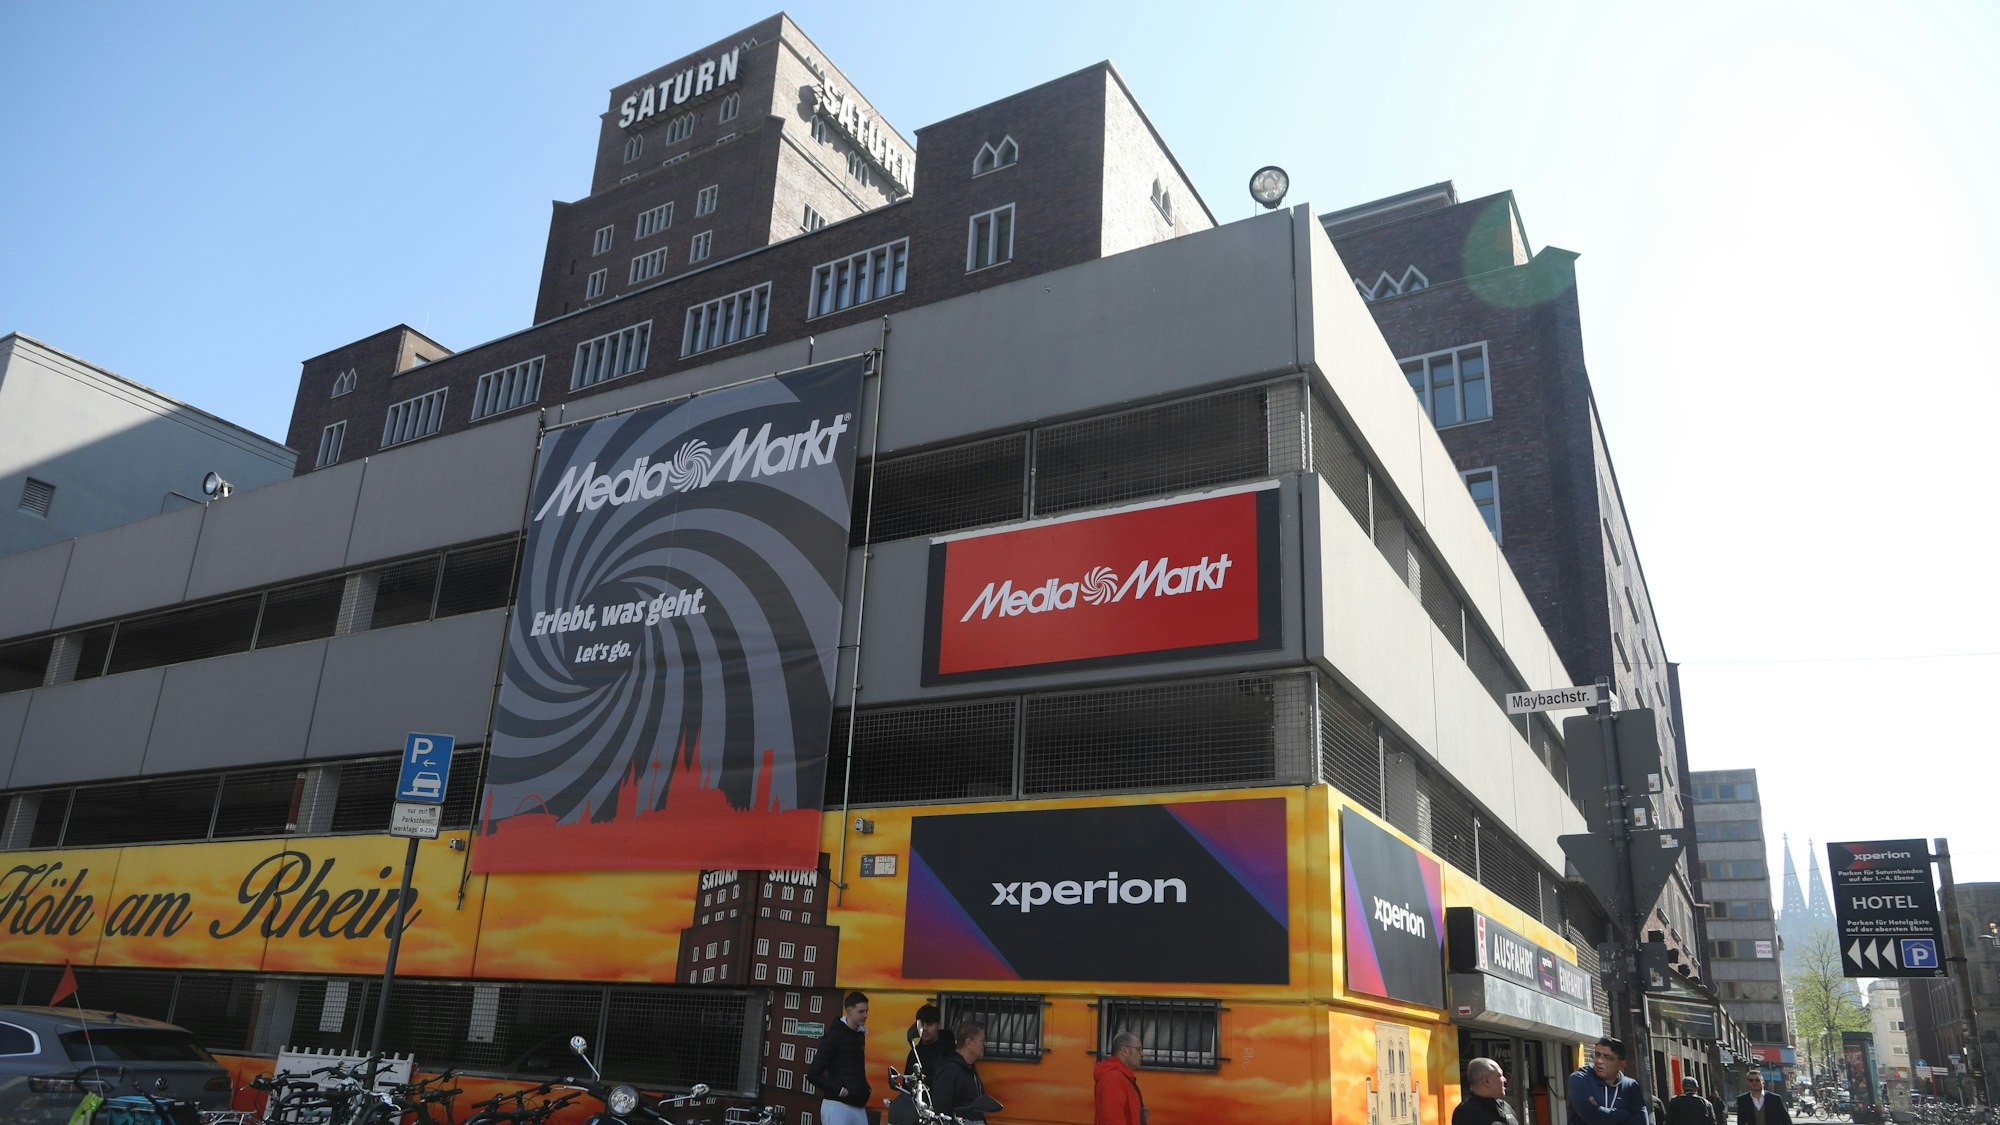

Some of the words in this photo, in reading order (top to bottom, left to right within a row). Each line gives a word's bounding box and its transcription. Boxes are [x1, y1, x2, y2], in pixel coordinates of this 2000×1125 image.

[618, 46, 740, 129] SATURN
[822, 77, 915, 192] SATURN
[530, 603, 597, 637] Erlebt,
[601, 600, 646, 627] was
[645, 588, 707, 627] geht.
[575, 642, 609, 664] Let's
[608, 639, 632, 663] go.
[1512, 691, 1590, 709] Maybachstr.
[411, 737, 434, 764] P
[393, 825, 418, 833] werktags
[1854, 851, 1911, 861] xperion
[701, 869, 739, 891] SATURN
[768, 869, 819, 888] SATURN
[1875, 868, 1924, 876] Saturnkunden
[0, 861, 96, 936] Köln
[104, 890, 193, 938] am
[209, 850, 422, 940] Rhein
[991, 872, 1187, 913] xperion
[1852, 895, 1919, 910] HOTEL
[1374, 895, 1426, 939] xperion
[1888, 919, 1930, 927] Hotelgäste
[1861, 925, 1873, 933] der
[1493, 932, 1535, 980] AUSFAHRT
[1912, 947, 1929, 966] P
